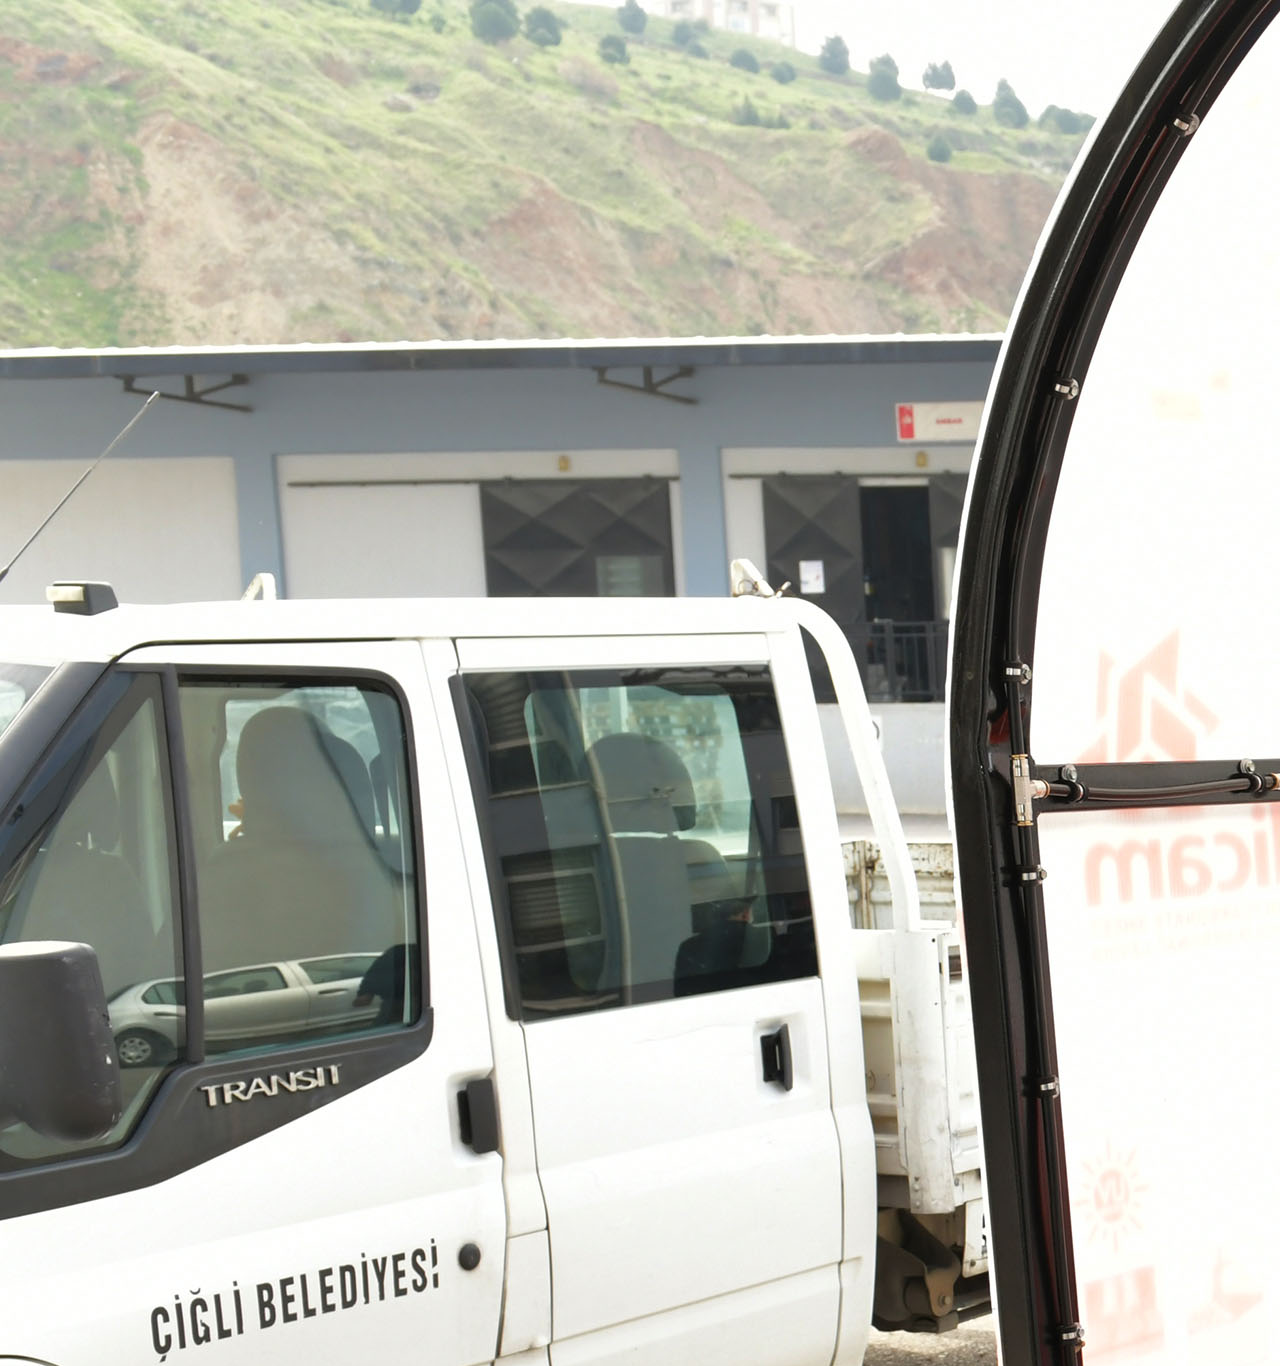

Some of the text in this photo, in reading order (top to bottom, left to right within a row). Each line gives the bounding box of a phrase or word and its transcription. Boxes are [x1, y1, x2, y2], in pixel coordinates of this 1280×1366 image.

[200, 1063, 342, 1107] TRANSIT
[150, 1238, 439, 1363] ÇİĞLİ BELEDİYESİ
